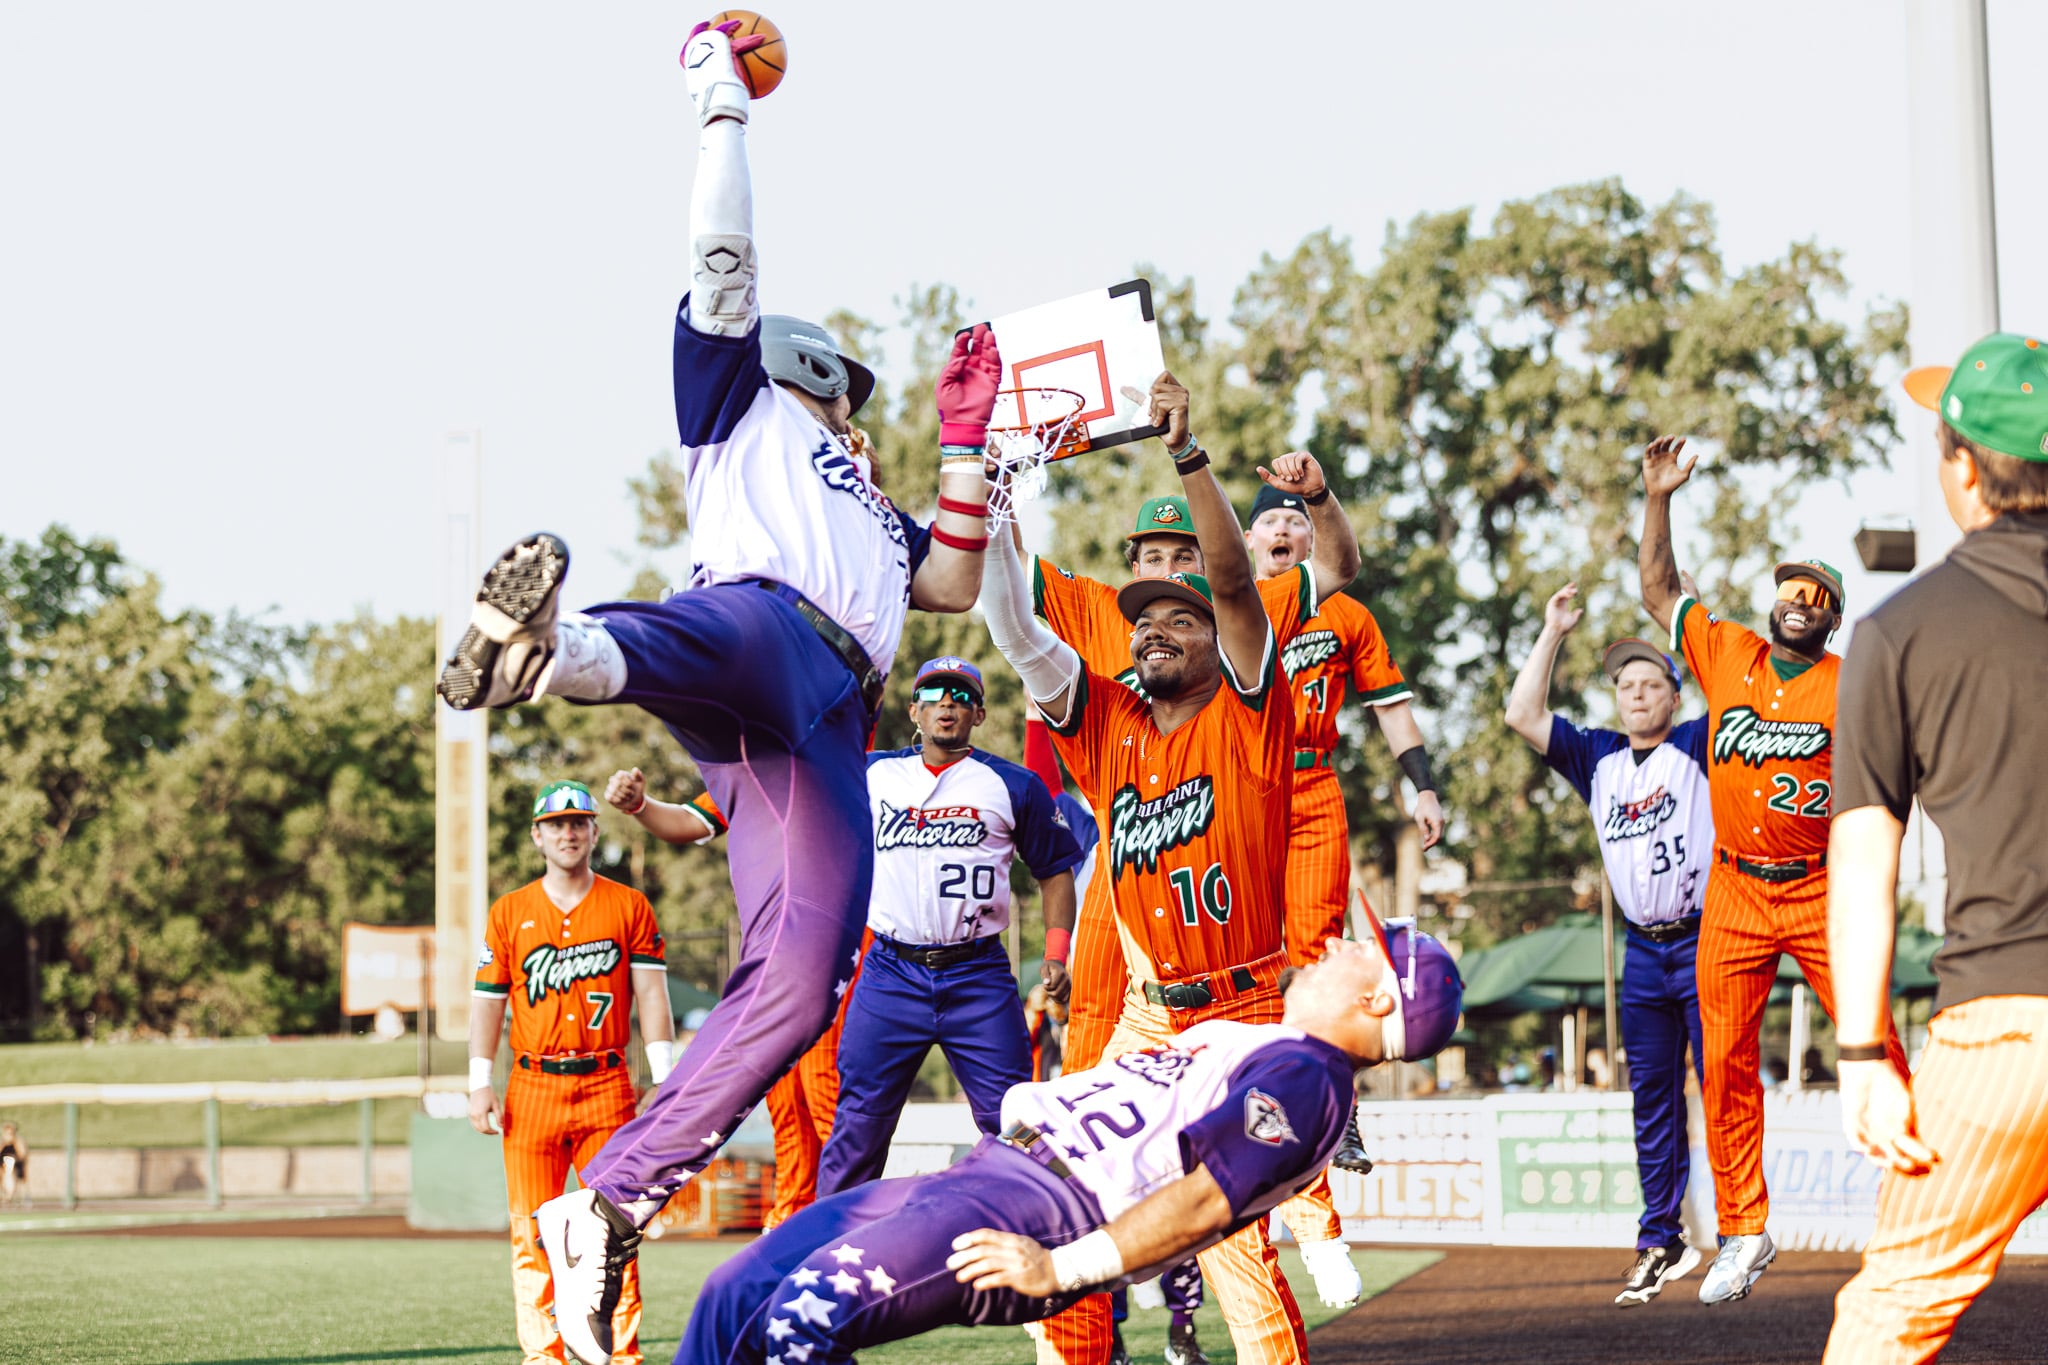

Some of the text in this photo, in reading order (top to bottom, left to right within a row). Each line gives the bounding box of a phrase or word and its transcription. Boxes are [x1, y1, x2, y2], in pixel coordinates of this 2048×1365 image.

[1714, 705, 1831, 769] Hoppers
[1753, 720, 1821, 734] DIAMOND
[910, 806, 974, 820] UTICA
[1767, 773, 1831, 818] 22
[876, 799, 989, 851] Unicorns
[1651, 834, 1686, 875] 35
[940, 863, 995, 900] 20
[522, 944, 621, 1008] Hoppers
[586, 991, 614, 1031] 7
